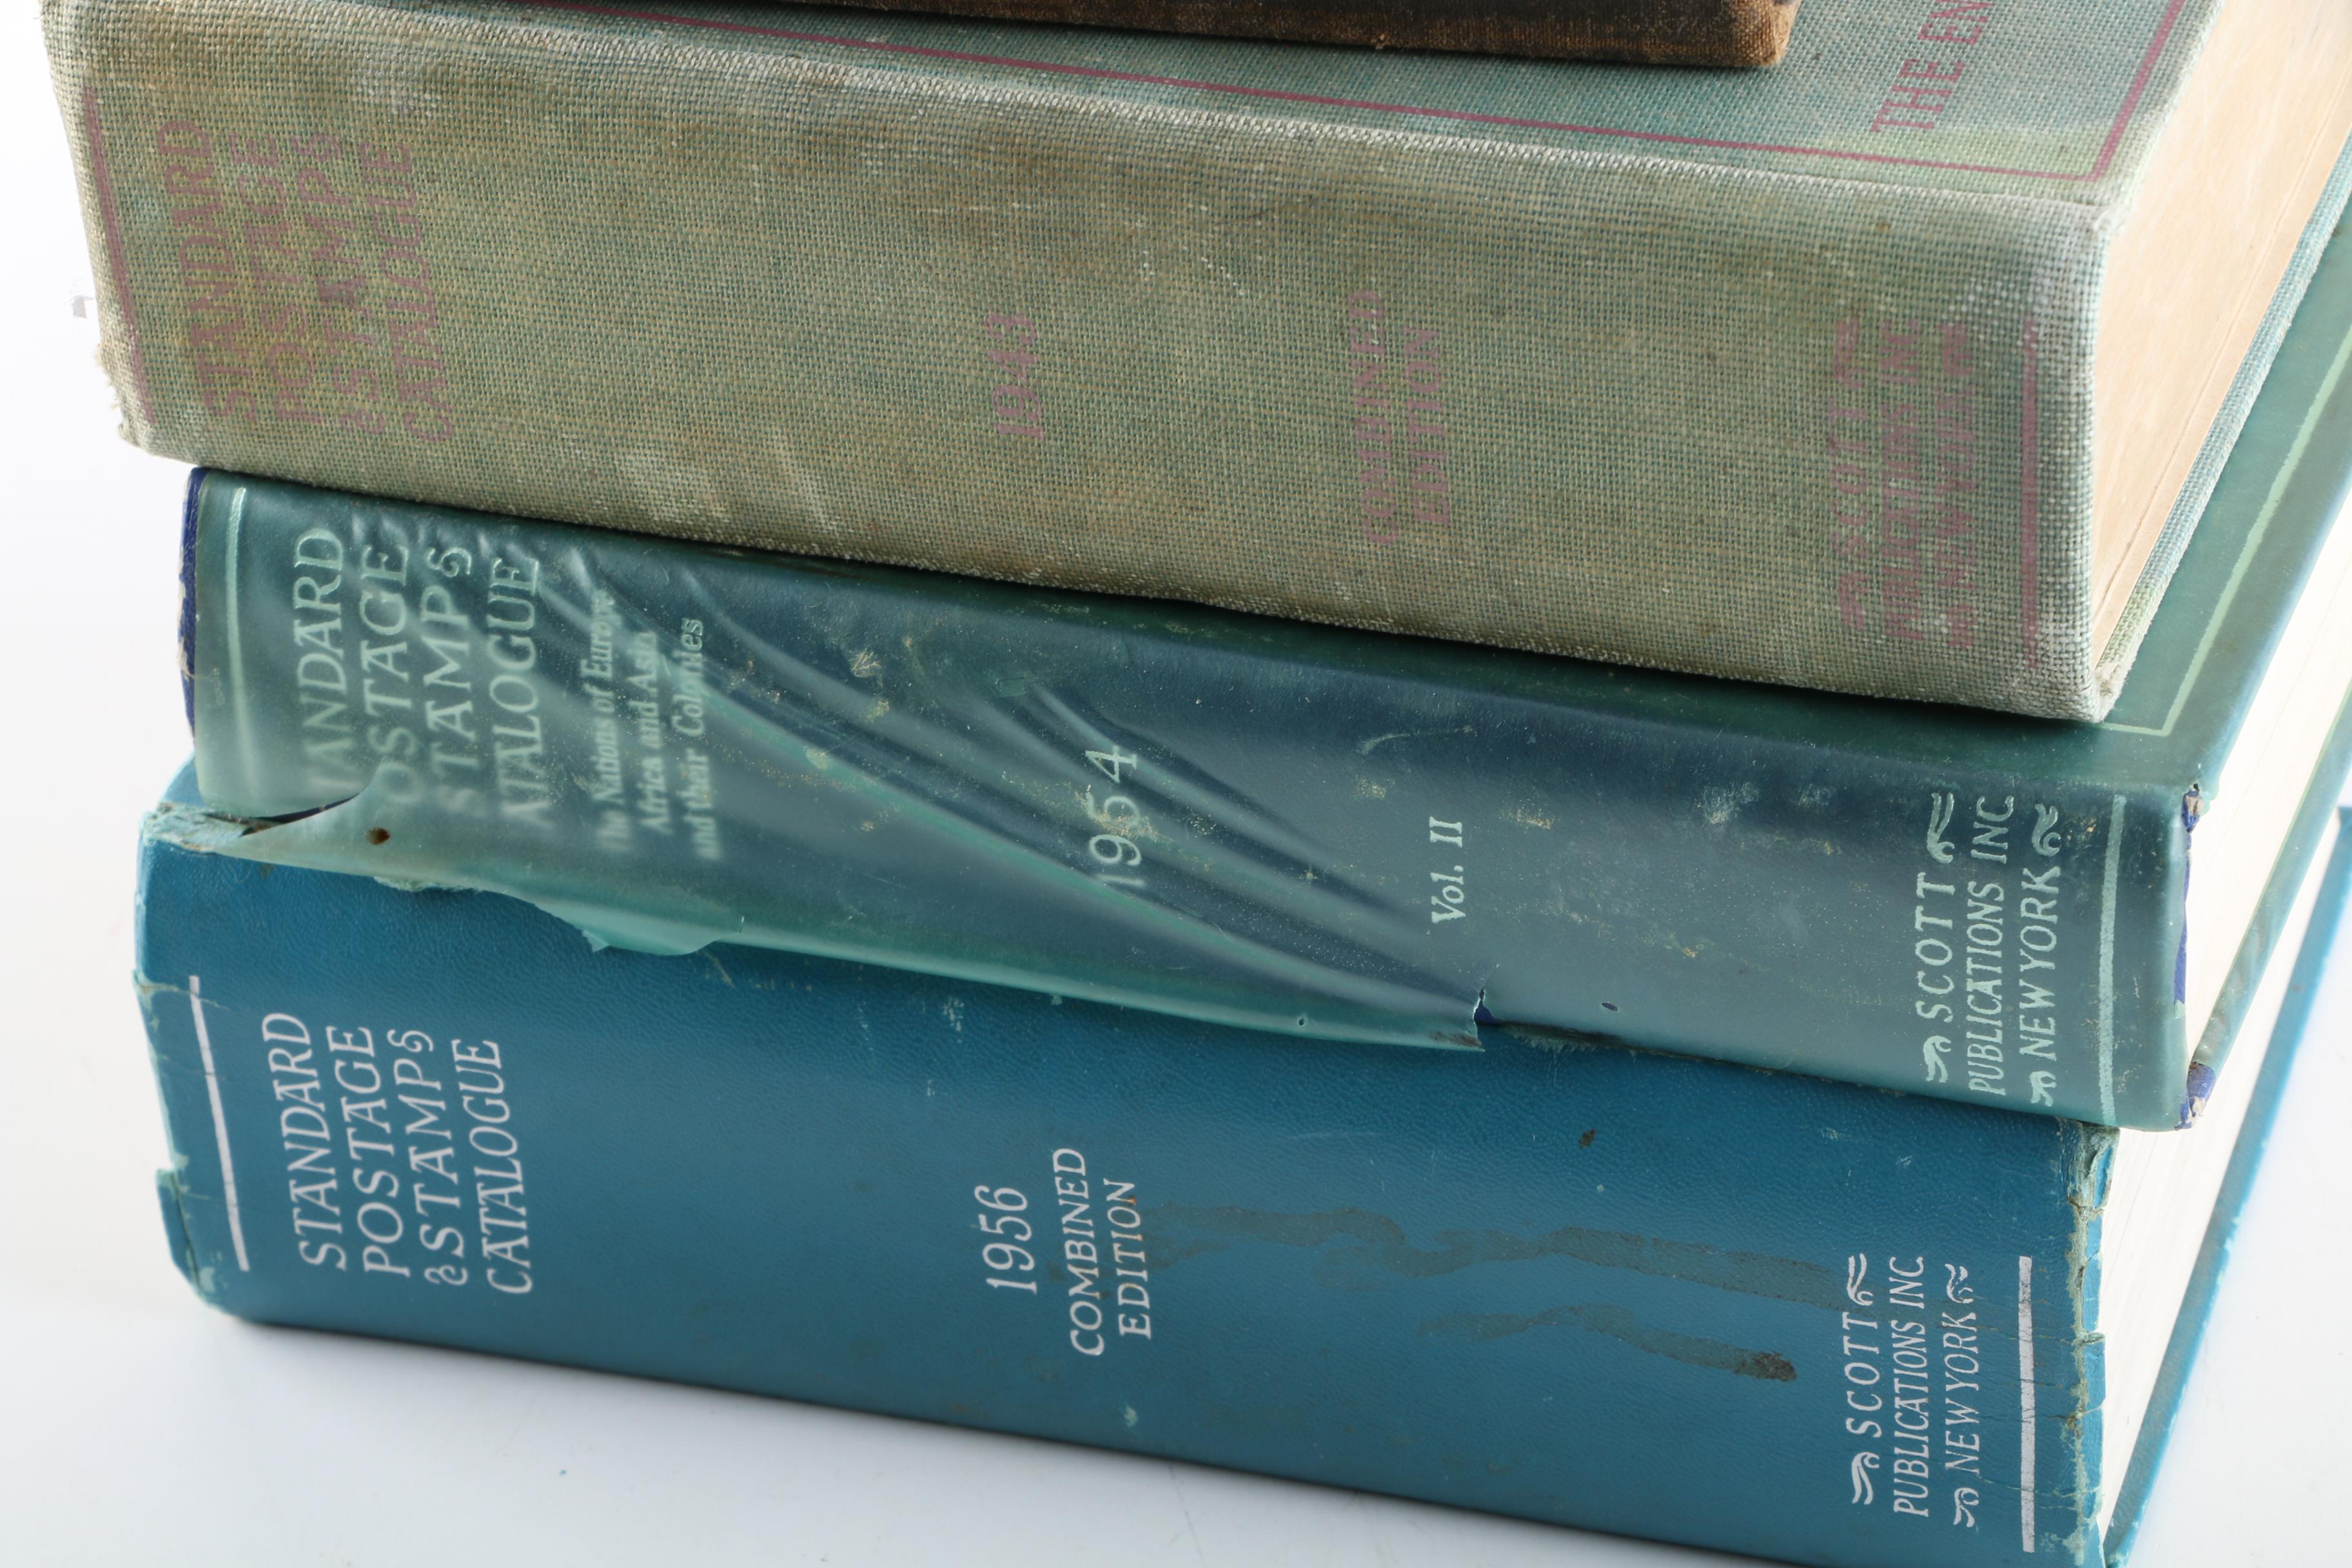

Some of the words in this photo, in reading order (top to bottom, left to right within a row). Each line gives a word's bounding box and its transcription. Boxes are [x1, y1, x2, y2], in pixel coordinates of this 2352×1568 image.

[1870, 59, 1965, 132] THE
[157, 121, 259, 422] STANDARD
[230, 132, 322, 424] POSTAGE
[360, 142, 453, 442] CATALOGUE
[985, 314, 1044, 441] 1943
[1880, 319, 1920, 386] INC
[1348, 289, 1399, 545] COMBINED
[1404, 326, 1450, 527] EDITION
[1935, 386, 1977, 495] YORK
[1829, 396, 1869, 559] SCOTT
[1880, 401, 1923, 640] PUBLICATIONS
[1935, 504, 1976, 591] NEW
[583, 681, 614, 714] of
[629, 700, 660, 749] and
[672, 617, 705, 737] Colonies
[589, 718, 626, 805] Nations
[638, 756, 673, 834] Africa
[678, 747, 710, 810] their
[1085, 745, 1148, 890] 1954
[1429, 816, 1464, 848] II
[1970, 796, 2014, 864] INC
[1430, 865, 1467, 923] Vol.
[1915, 872, 1955, 1023] SCOTT
[2019, 866, 2061, 971] YORK
[1966, 881, 2006, 1096] PUBLICATIONS
[2019, 979, 2057, 1062] NEW
[262, 1013, 347, 1271] STANDARD
[326, 1026, 411, 1278] POSTAGE
[451, 1039, 533, 1294] CATALOGUE
[974, 1185, 1037, 1295] 1956
[1052, 1148, 1105, 1356] COMBINED
[1103, 1178, 1152, 1340] EDITION
[1889, 1256, 1925, 1309] INC
[1842, 1312, 1883, 1438] SCOTT
[1941, 1312, 1979, 1392] YORK
[1892, 1320, 1929, 1518] PUBLICATIONS
[1945, 1398, 1980, 1475] NEW
